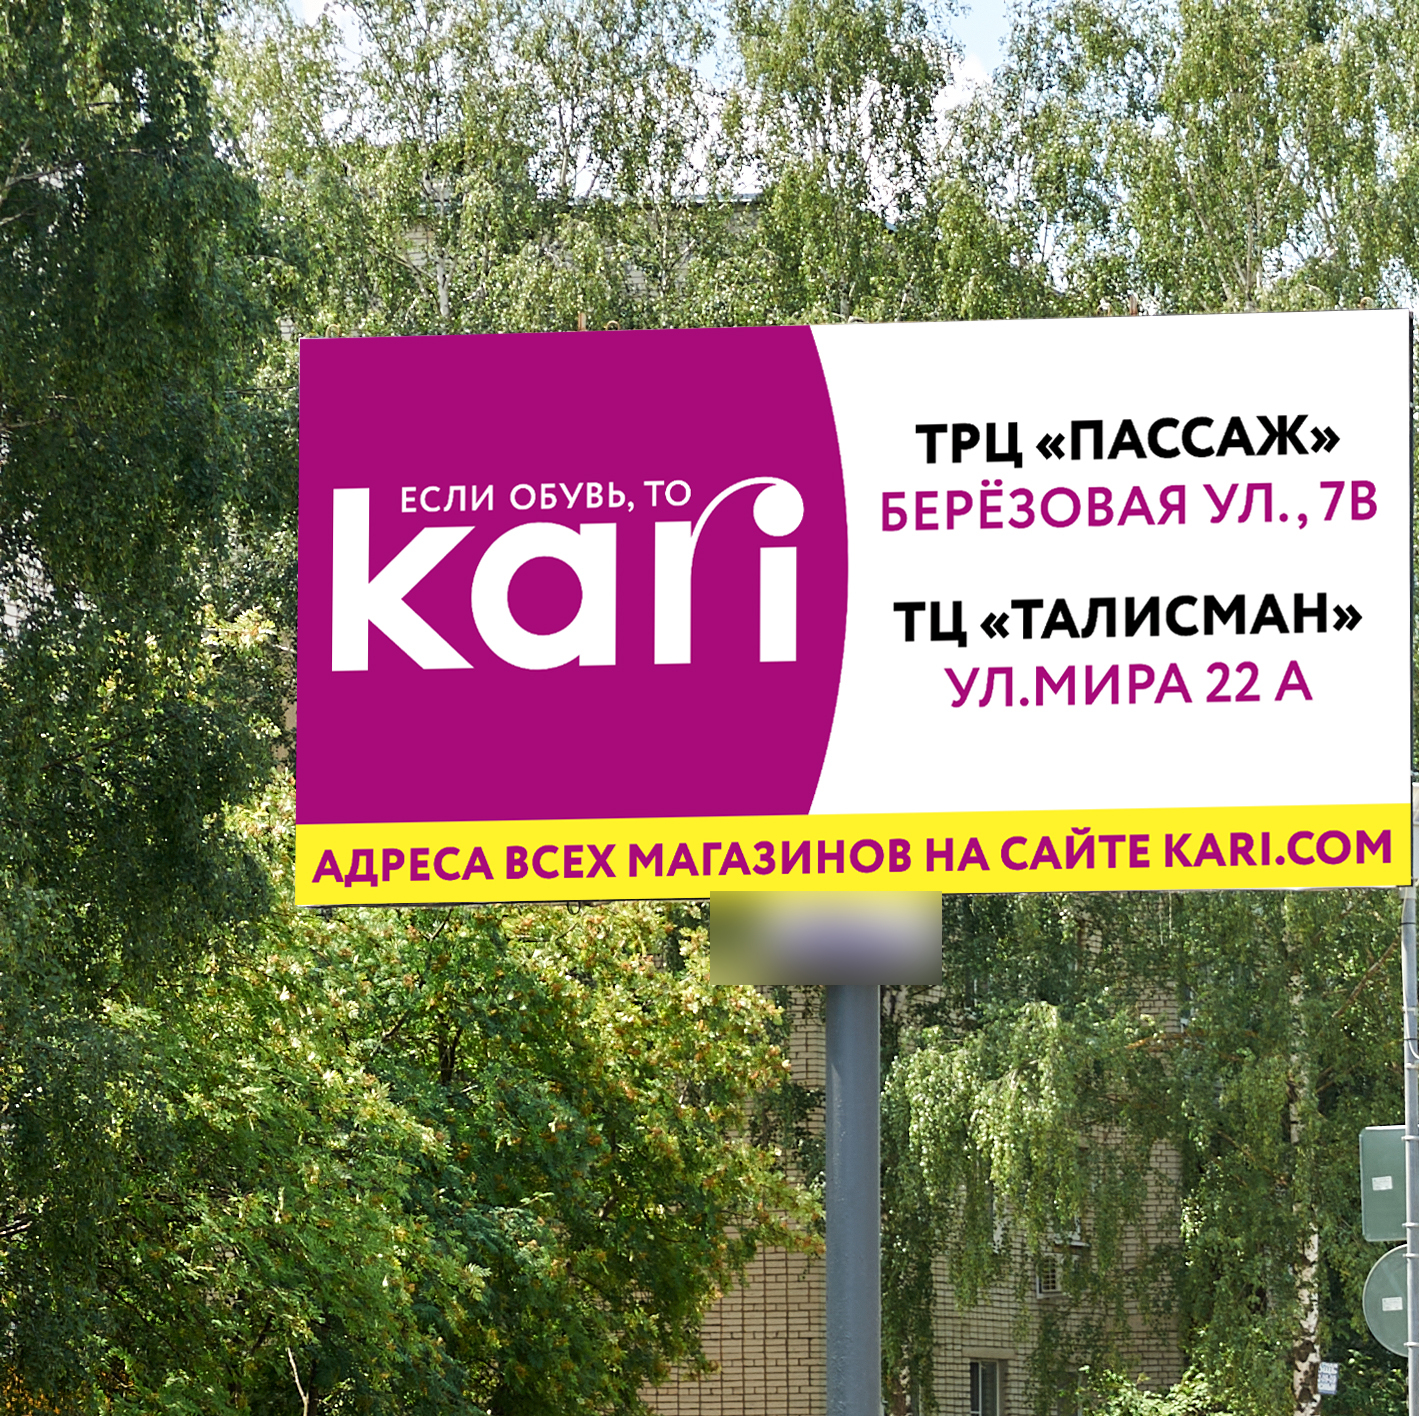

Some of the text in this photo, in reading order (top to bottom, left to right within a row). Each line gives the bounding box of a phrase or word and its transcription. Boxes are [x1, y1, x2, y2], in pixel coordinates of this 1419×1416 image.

[915, 414, 1341, 469] ТРЦ «ПАССАЖ»
[401, 479, 692, 513] ЕСЛИ ОБУВЬ, ТО
[881, 478, 1378, 532] БЕРЁЗОВАЯ УЛ., 7В
[331, 476, 805, 672] kari
[893, 592, 1363, 648] ТЦ «ТАЛИСМАН»
[1206, 660, 1261, 703] 22
[1274, 660, 1313, 702] А
[311, 827, 1392, 888] АДРЕСА ВСЕХ МАГАЗИНОВ НА САЙТЕ KARI.COM
